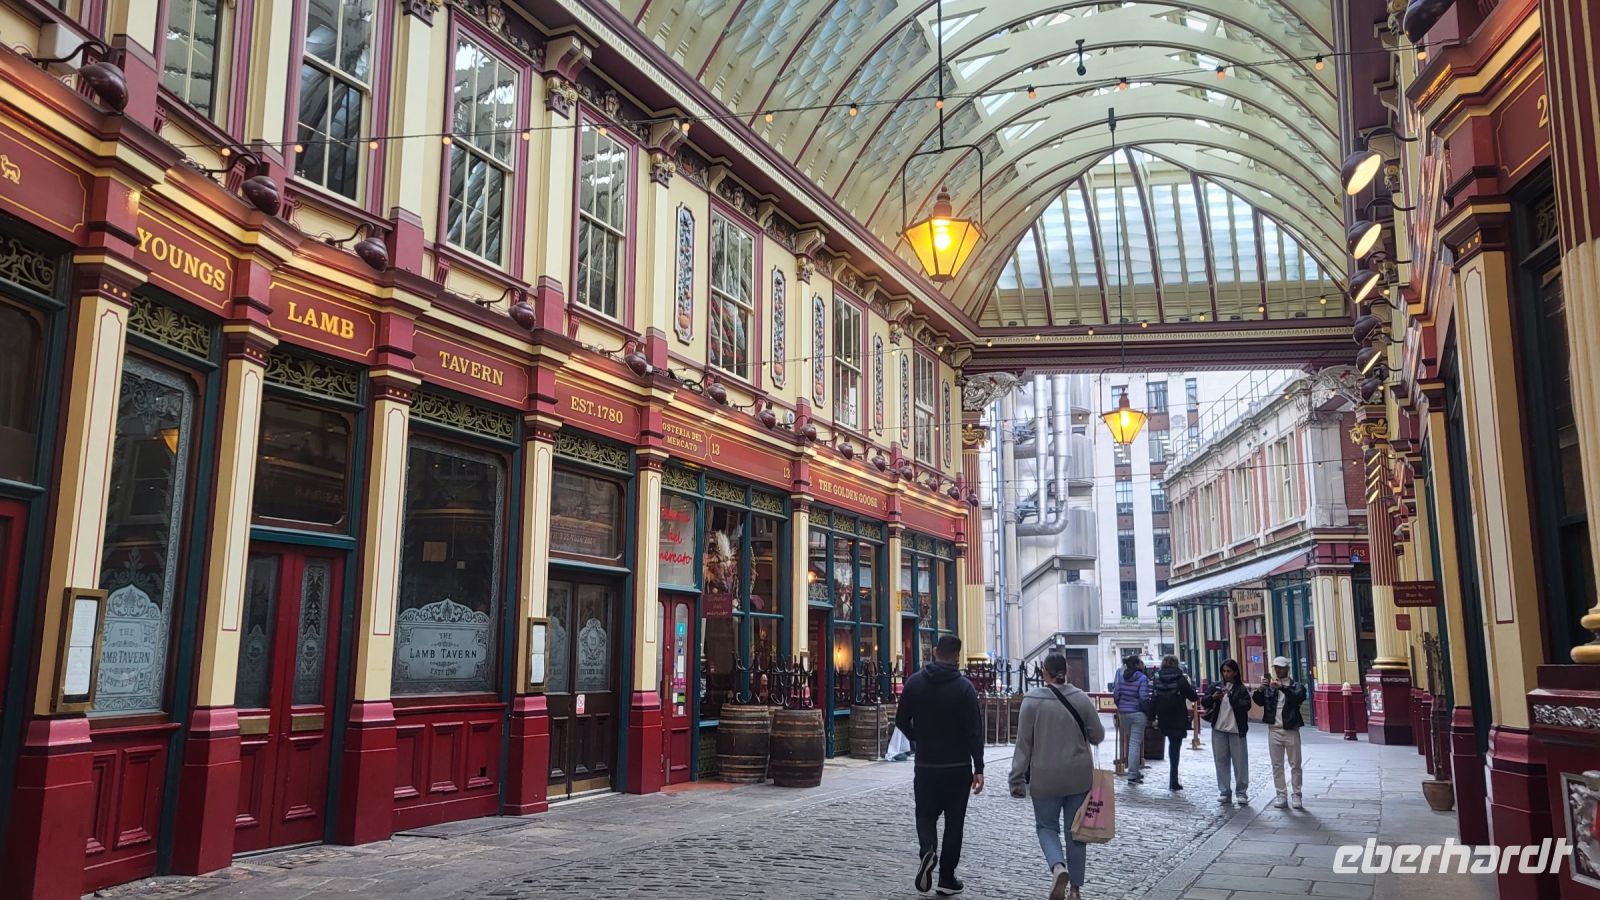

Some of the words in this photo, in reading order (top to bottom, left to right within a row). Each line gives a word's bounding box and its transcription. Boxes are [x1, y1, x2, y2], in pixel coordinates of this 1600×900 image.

[137, 226, 226, 292] YOUNGS
[288, 302, 354, 340] LAMB
[439, 350, 504, 387] TAVERN
[571, 396, 623, 425] EST.1780
[662, 422, 691, 439] OSTERIA
[691, 431, 703, 443] DEL
[666, 436, 698, 452] MERCATO
[711, 443, 720, 456] 13
[783, 467, 791, 479] 13
[818, 479, 832, 493] THE
[832, 485, 858, 502] GOLDEN
[858, 493, 878, 508] GOOSE
[119, 628, 135, 637] THE
[440, 632, 452, 640] THE
[101, 651, 117, 664] AMB
[118, 650, 151, 664] TAVERN
[409, 647, 436, 659] LAMB
[441, 648, 477, 659] TAVERN
